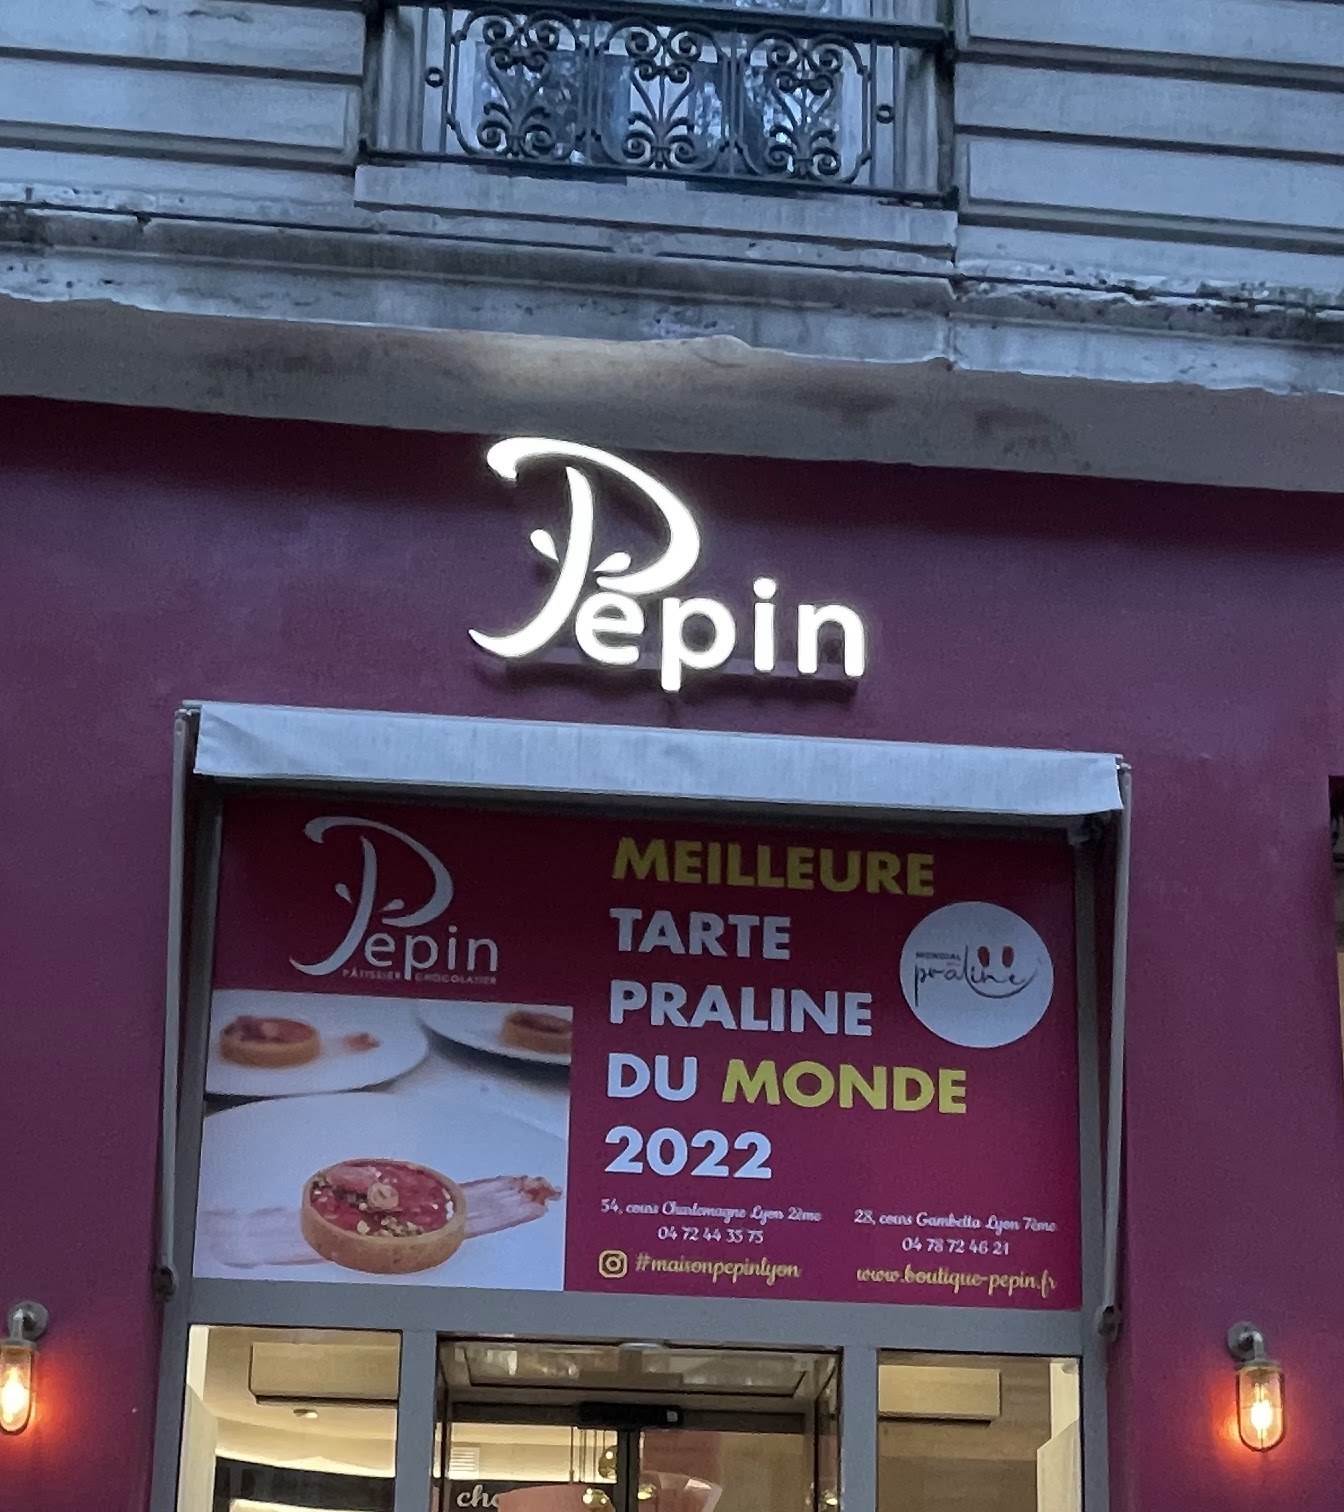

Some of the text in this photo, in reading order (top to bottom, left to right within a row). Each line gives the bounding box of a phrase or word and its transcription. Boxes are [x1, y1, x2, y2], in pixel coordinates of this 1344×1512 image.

[611, 838, 935, 898] MEILLEURE
[610, 908, 791, 961] TARTE
[609, 980, 873, 1038] PRALINE
[608, 1053, 968, 1114] DU MONDE
[604, 1127, 773, 1180] 2022
[626, 1203, 659, 1214] cours
[662, 1201, 746, 1223] Charlemagne
[750, 1205, 785, 1225] Lyon
[879, 1214, 912, 1226] cours
[916, 1211, 981, 1228] Gambetta
[985, 1215, 1020, 1236] Lyon
[657, 1226, 678, 1240] 04
[681, 1227, 699, 1241] 72
[703, 1228, 722, 1241] 44
[747, 1230, 764, 1244] 75
[902, 1237, 1009, 1255] 04 78 72 46 21
[634, 1252, 801, 1287] #maisonpepinlyon
[856, 1263, 1056, 1299] www.boutique-pepin.fr
